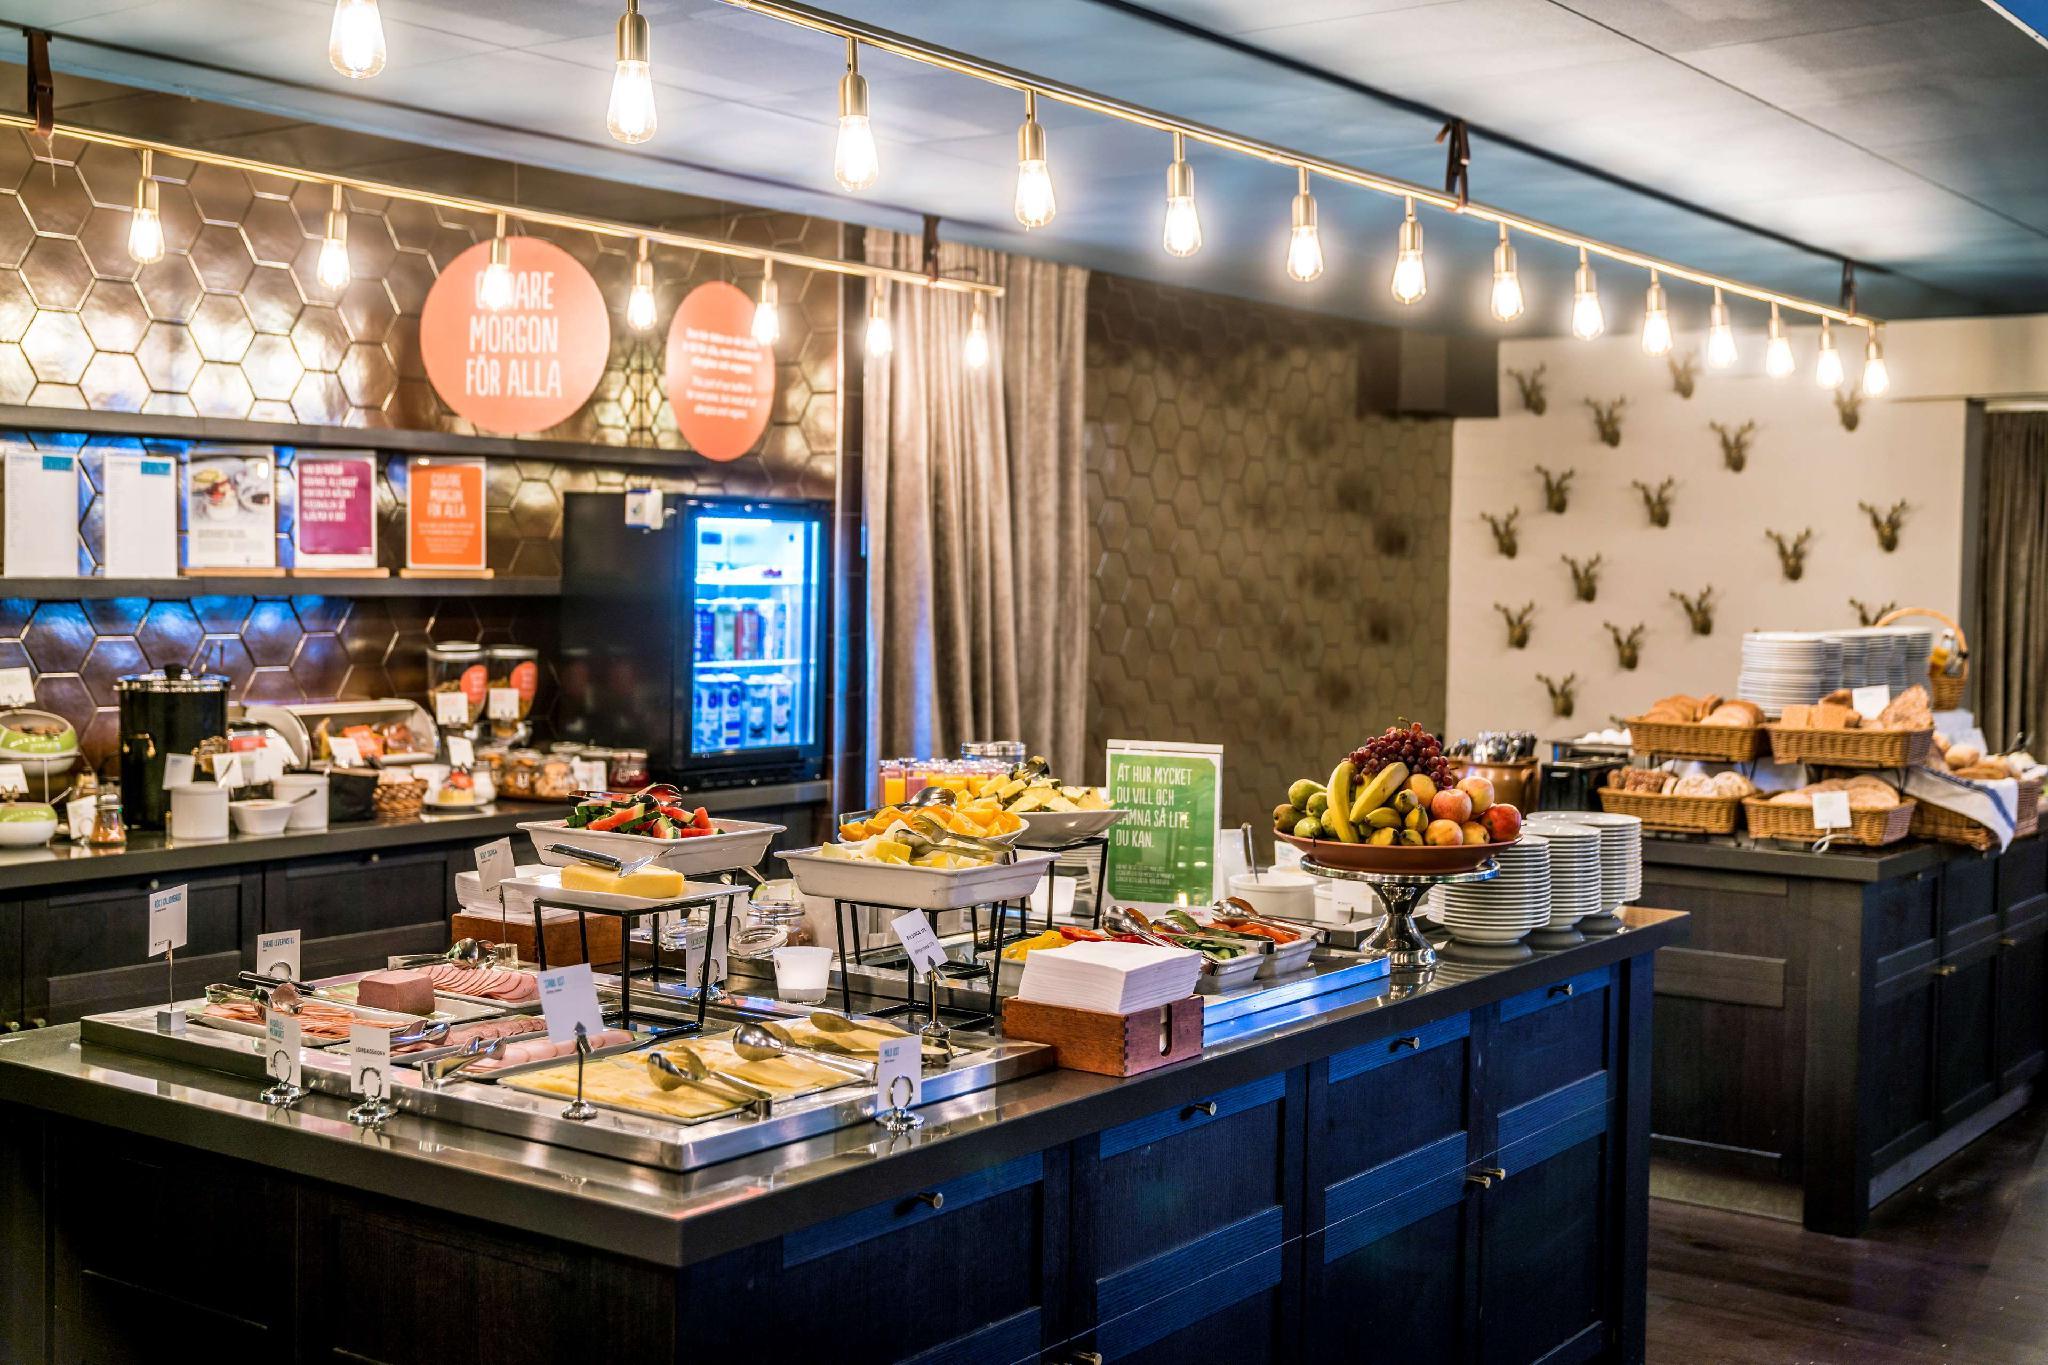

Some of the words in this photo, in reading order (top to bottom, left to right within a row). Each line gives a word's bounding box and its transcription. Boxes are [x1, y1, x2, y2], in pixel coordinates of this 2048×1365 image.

[469, 315, 559, 353] MORGON
[465, 354, 501, 397] FÖR
[506, 359, 563, 398] ALLA
[1133, 766, 1151, 783] HUR
[1154, 766, 1192, 785] MYCKET
[1117, 786, 1130, 803] DU
[1132, 787, 1153, 805] VILL
[1156, 788, 1174, 806] OCH
[1154, 807, 1167, 828] SÅ
[1169, 811, 1190, 829] LITE
[1116, 829, 1129, 846] DU
